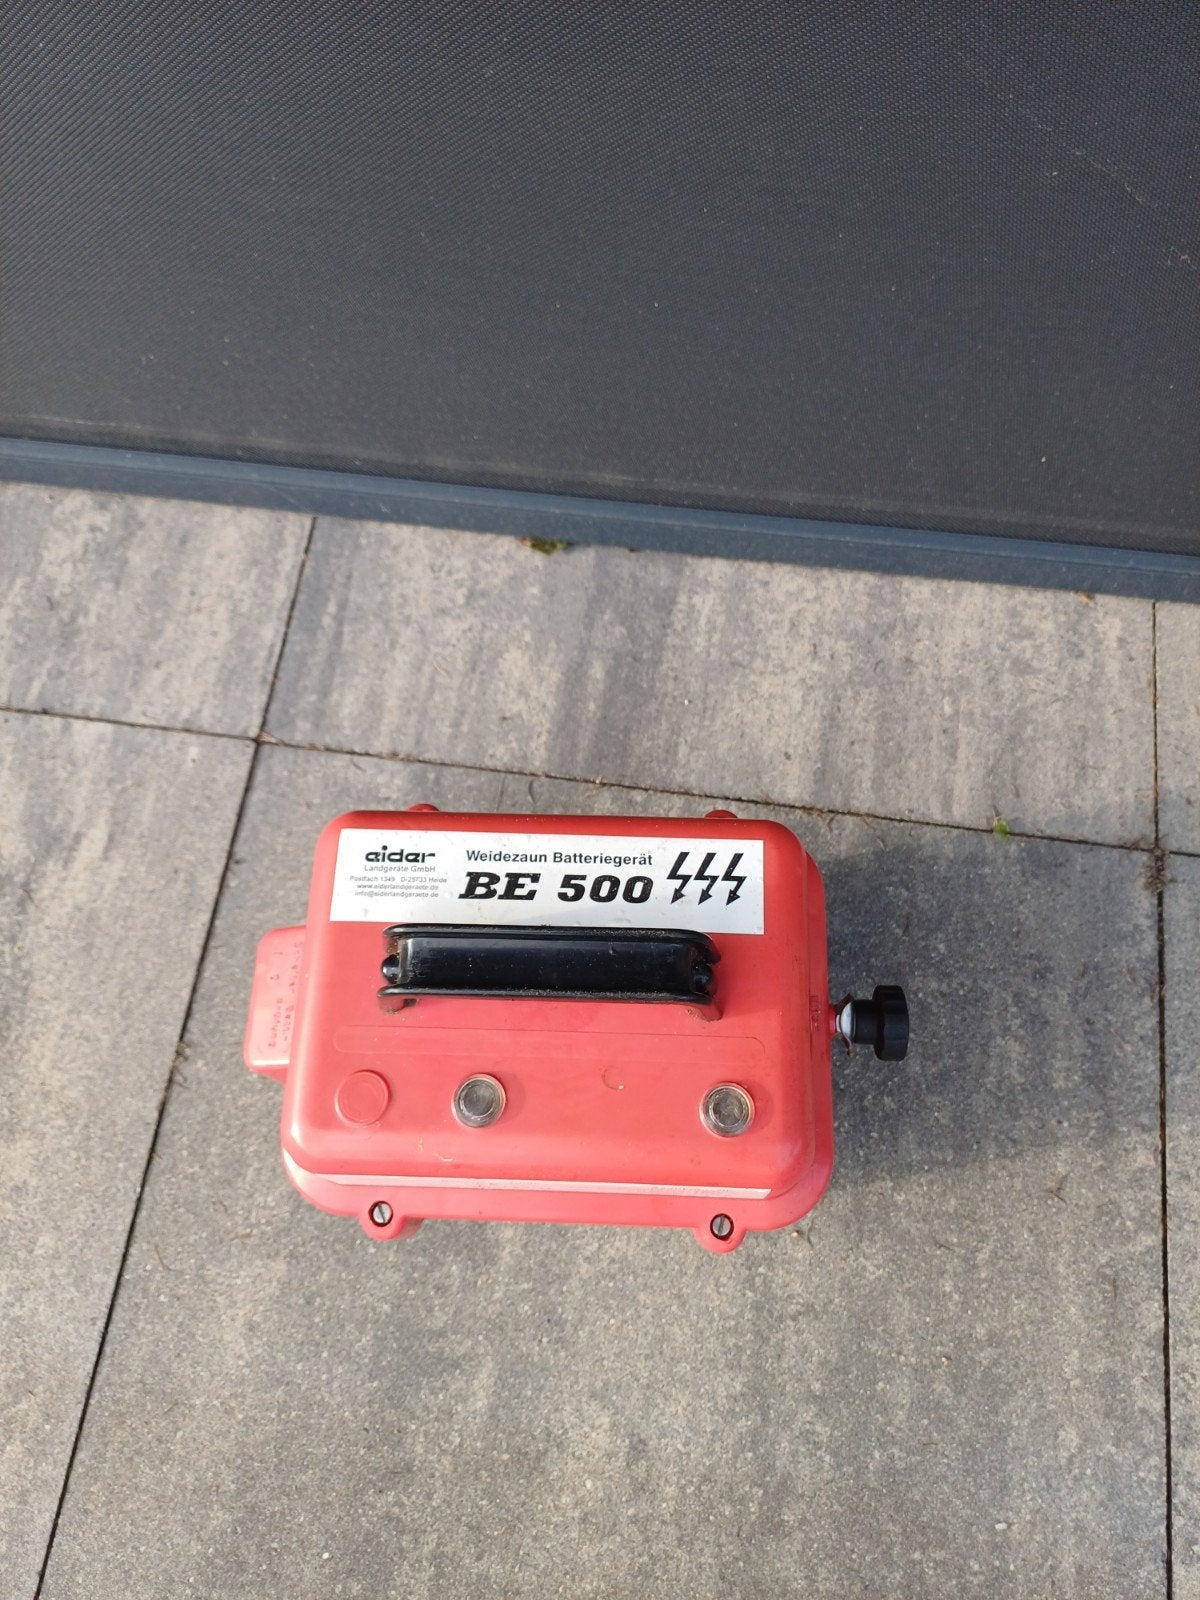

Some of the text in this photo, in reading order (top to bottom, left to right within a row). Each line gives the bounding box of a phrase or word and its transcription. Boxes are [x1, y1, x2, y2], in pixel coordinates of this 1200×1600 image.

[466, 850, 652, 867] Weidezaun Batteriegerät
[364, 865, 436, 873] Landgeräte GmbH
[458, 871, 654, 904] BE 500
